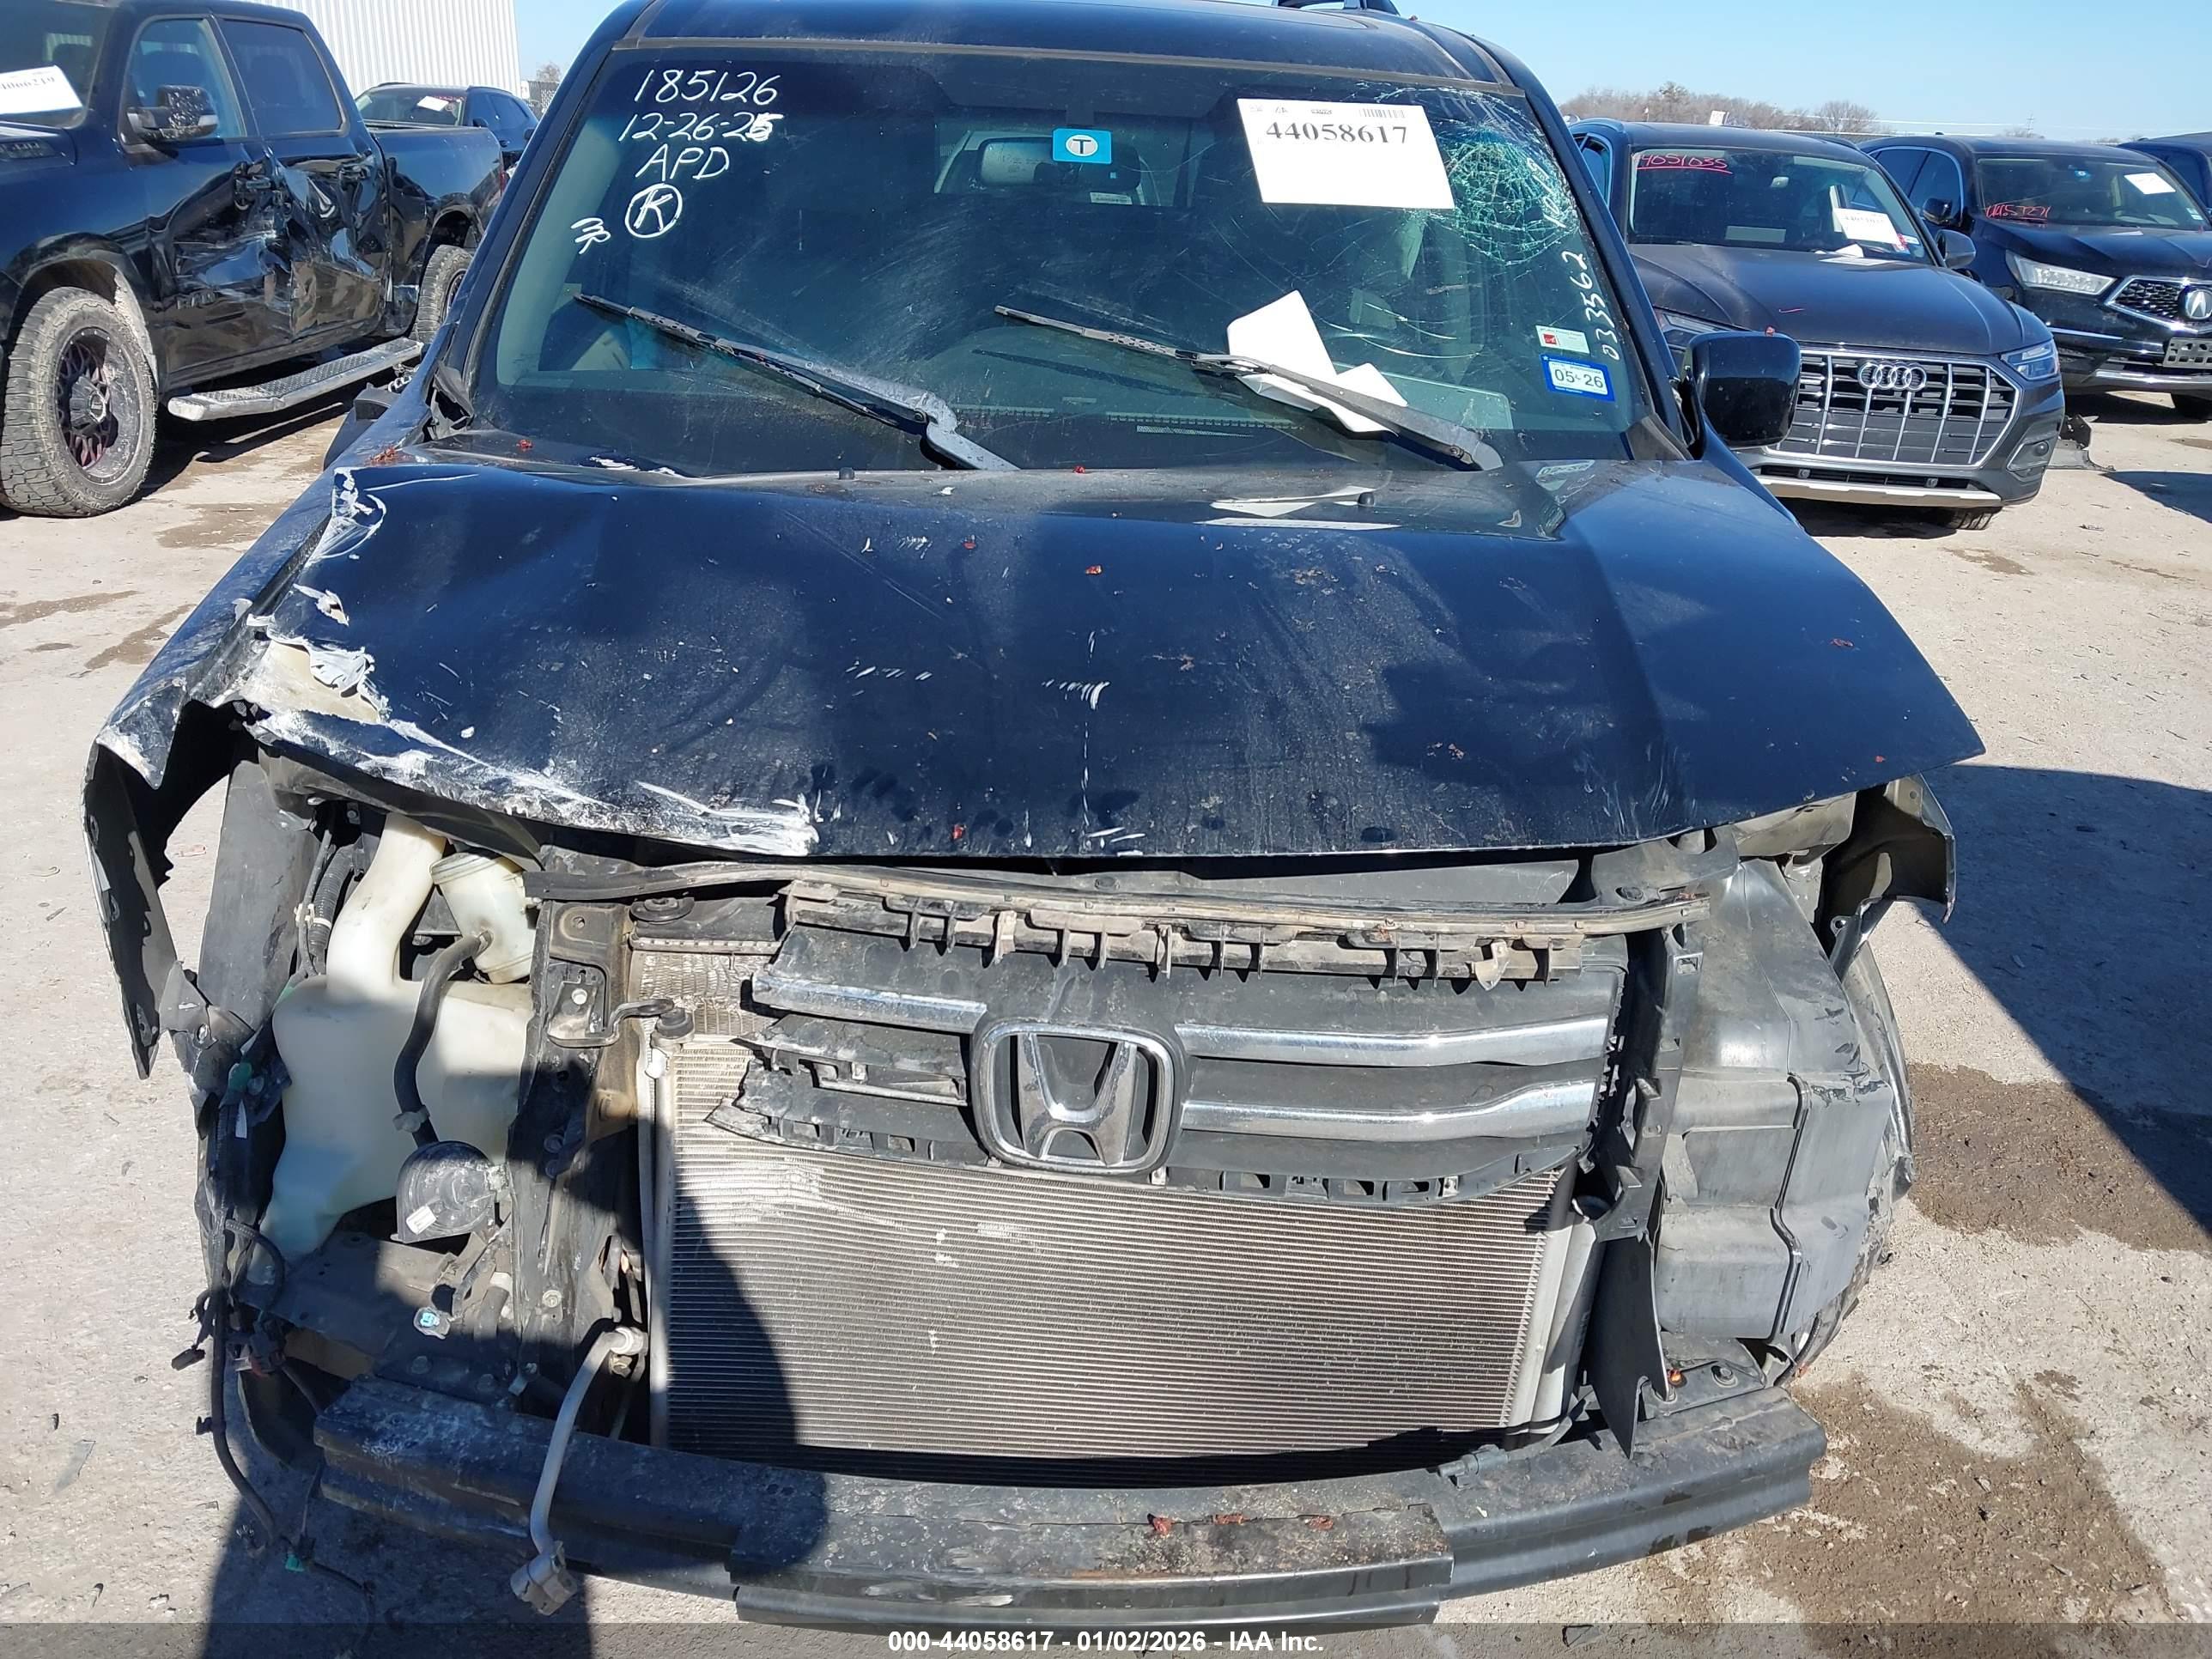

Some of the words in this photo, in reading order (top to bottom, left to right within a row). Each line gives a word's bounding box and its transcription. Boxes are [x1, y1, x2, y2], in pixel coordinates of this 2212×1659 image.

[634, 69, 781, 106] 185126
[1072, 137, 1092, 155] T
[1266, 121, 1408, 144] 44058617
[635, 143, 731, 182] APD
[632, 186, 674, 232] K
[1561, 249, 1621, 362] 033562
[1583, 374, 1604, 389] 26
